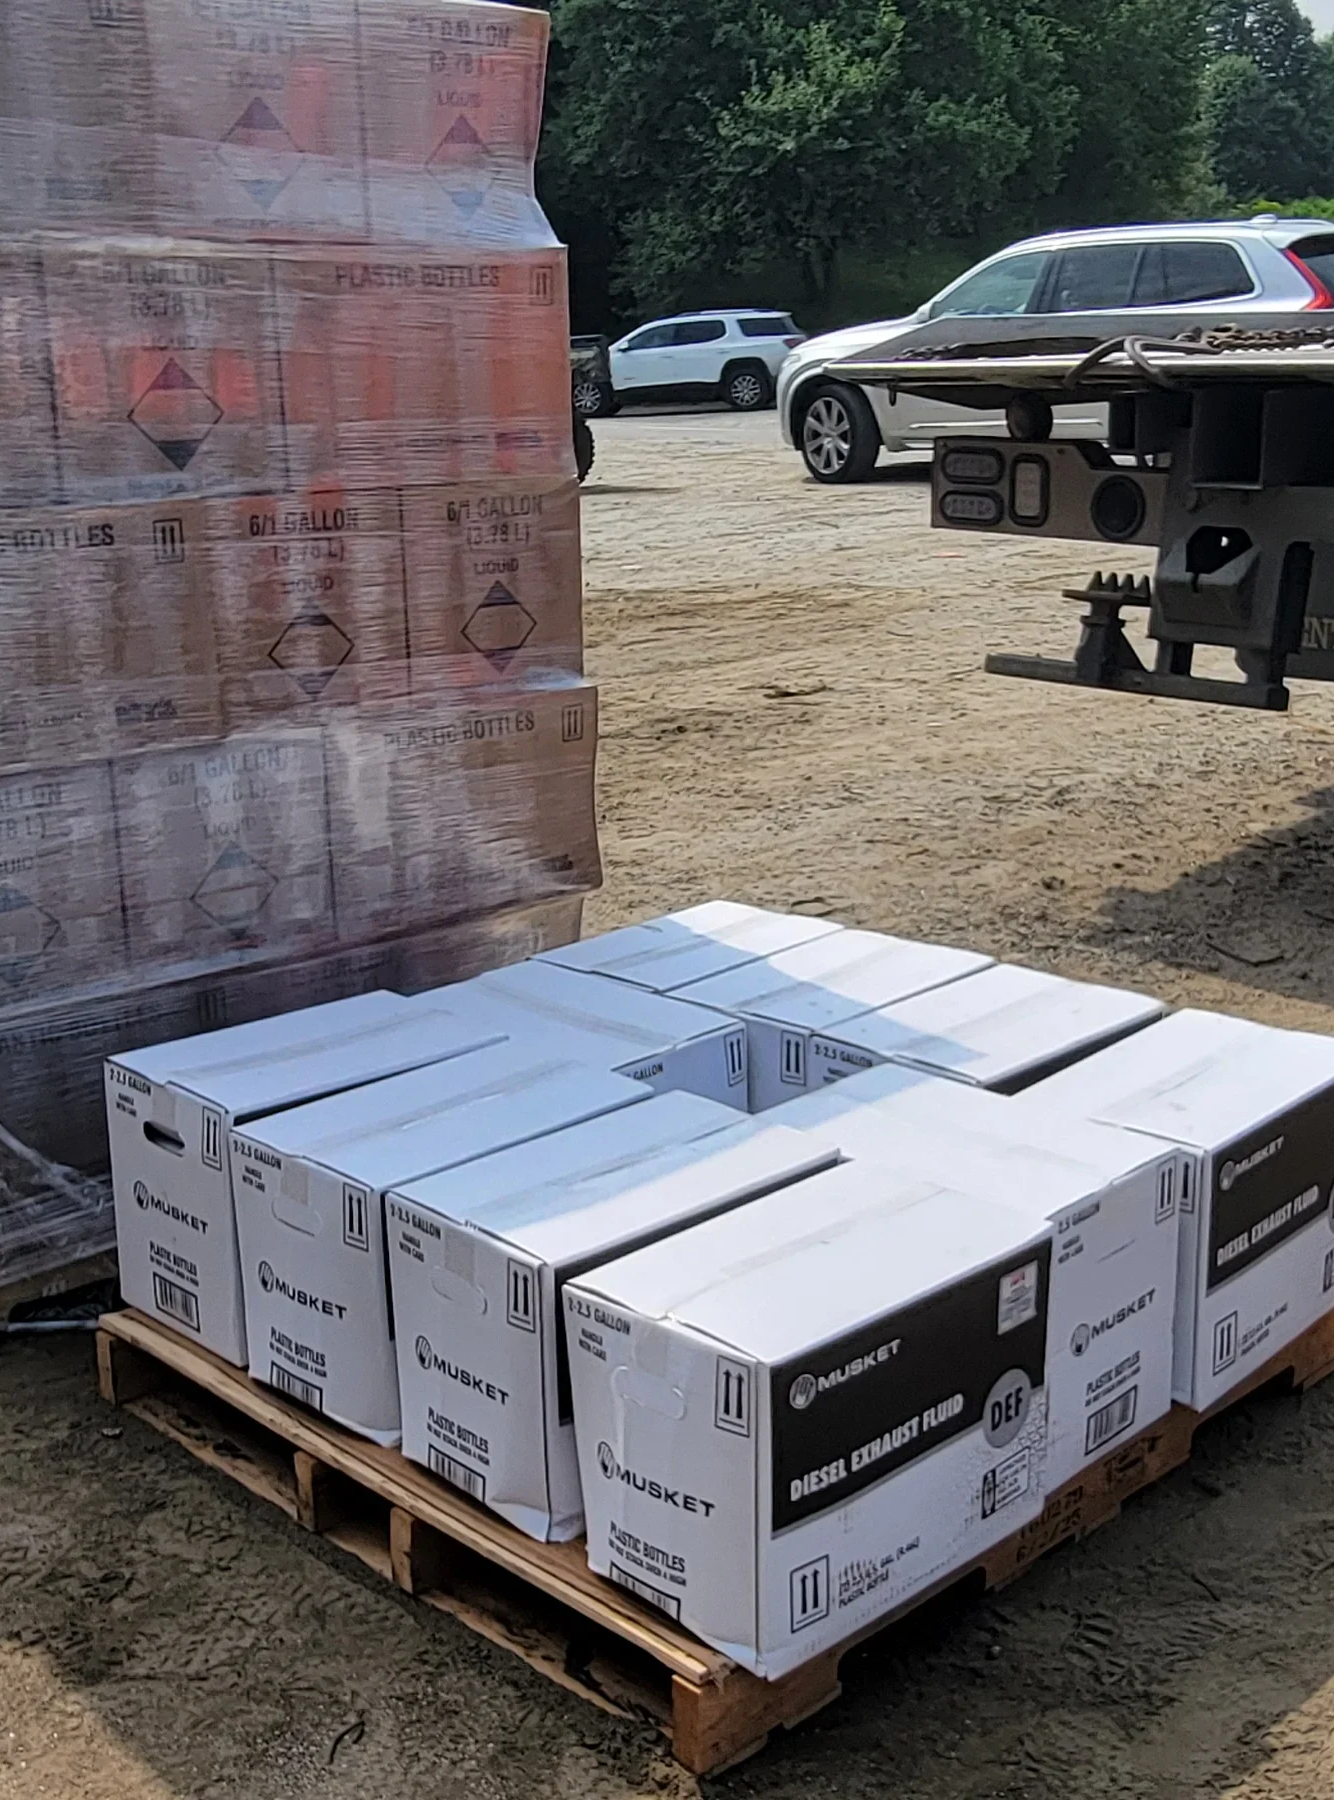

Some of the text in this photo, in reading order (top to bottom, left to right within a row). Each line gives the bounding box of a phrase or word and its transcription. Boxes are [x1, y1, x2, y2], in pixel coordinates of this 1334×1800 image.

[284, 508, 359, 532] GALLON
[478, 494, 543, 519] GALLON
[463, 711, 536, 740] BOTTLES
[128, 1075, 152, 1097] GALLON
[633, 1061, 664, 1080] GALLON
[253, 1147, 282, 1171] GALLON
[150, 1194, 209, 1235] MUSKET
[412, 1213, 441, 1241] GALLON
[1216, 1231, 1250, 1267] DIESEL
[1251, 1201, 1293, 1245] EXHAUST
[274, 1276, 348, 1322] MUSKET
[593, 1307, 632, 1336] GALLON
[1090, 1287, 1156, 1340] MUSKET
[270, 1326, 326, 1368] PLASTIC BOTTLES
[816, 1338, 903, 1394] MUSKET
[432, 1356, 510, 1406] MUSKET
[1085, 1368, 1114, 1396] PLASTIC
[1114, 1349, 1141, 1378] BOTTLES
[428, 1405, 489, 1455] PLASTIC BOTTLES
[989, 1384, 1025, 1433] DEF
[789, 1392, 966, 1503] DIESEL EXHAUST FLUID
[615, 1463, 716, 1519] MUSKET
[610, 1520, 687, 1574] PLASTIC BOTTLES
